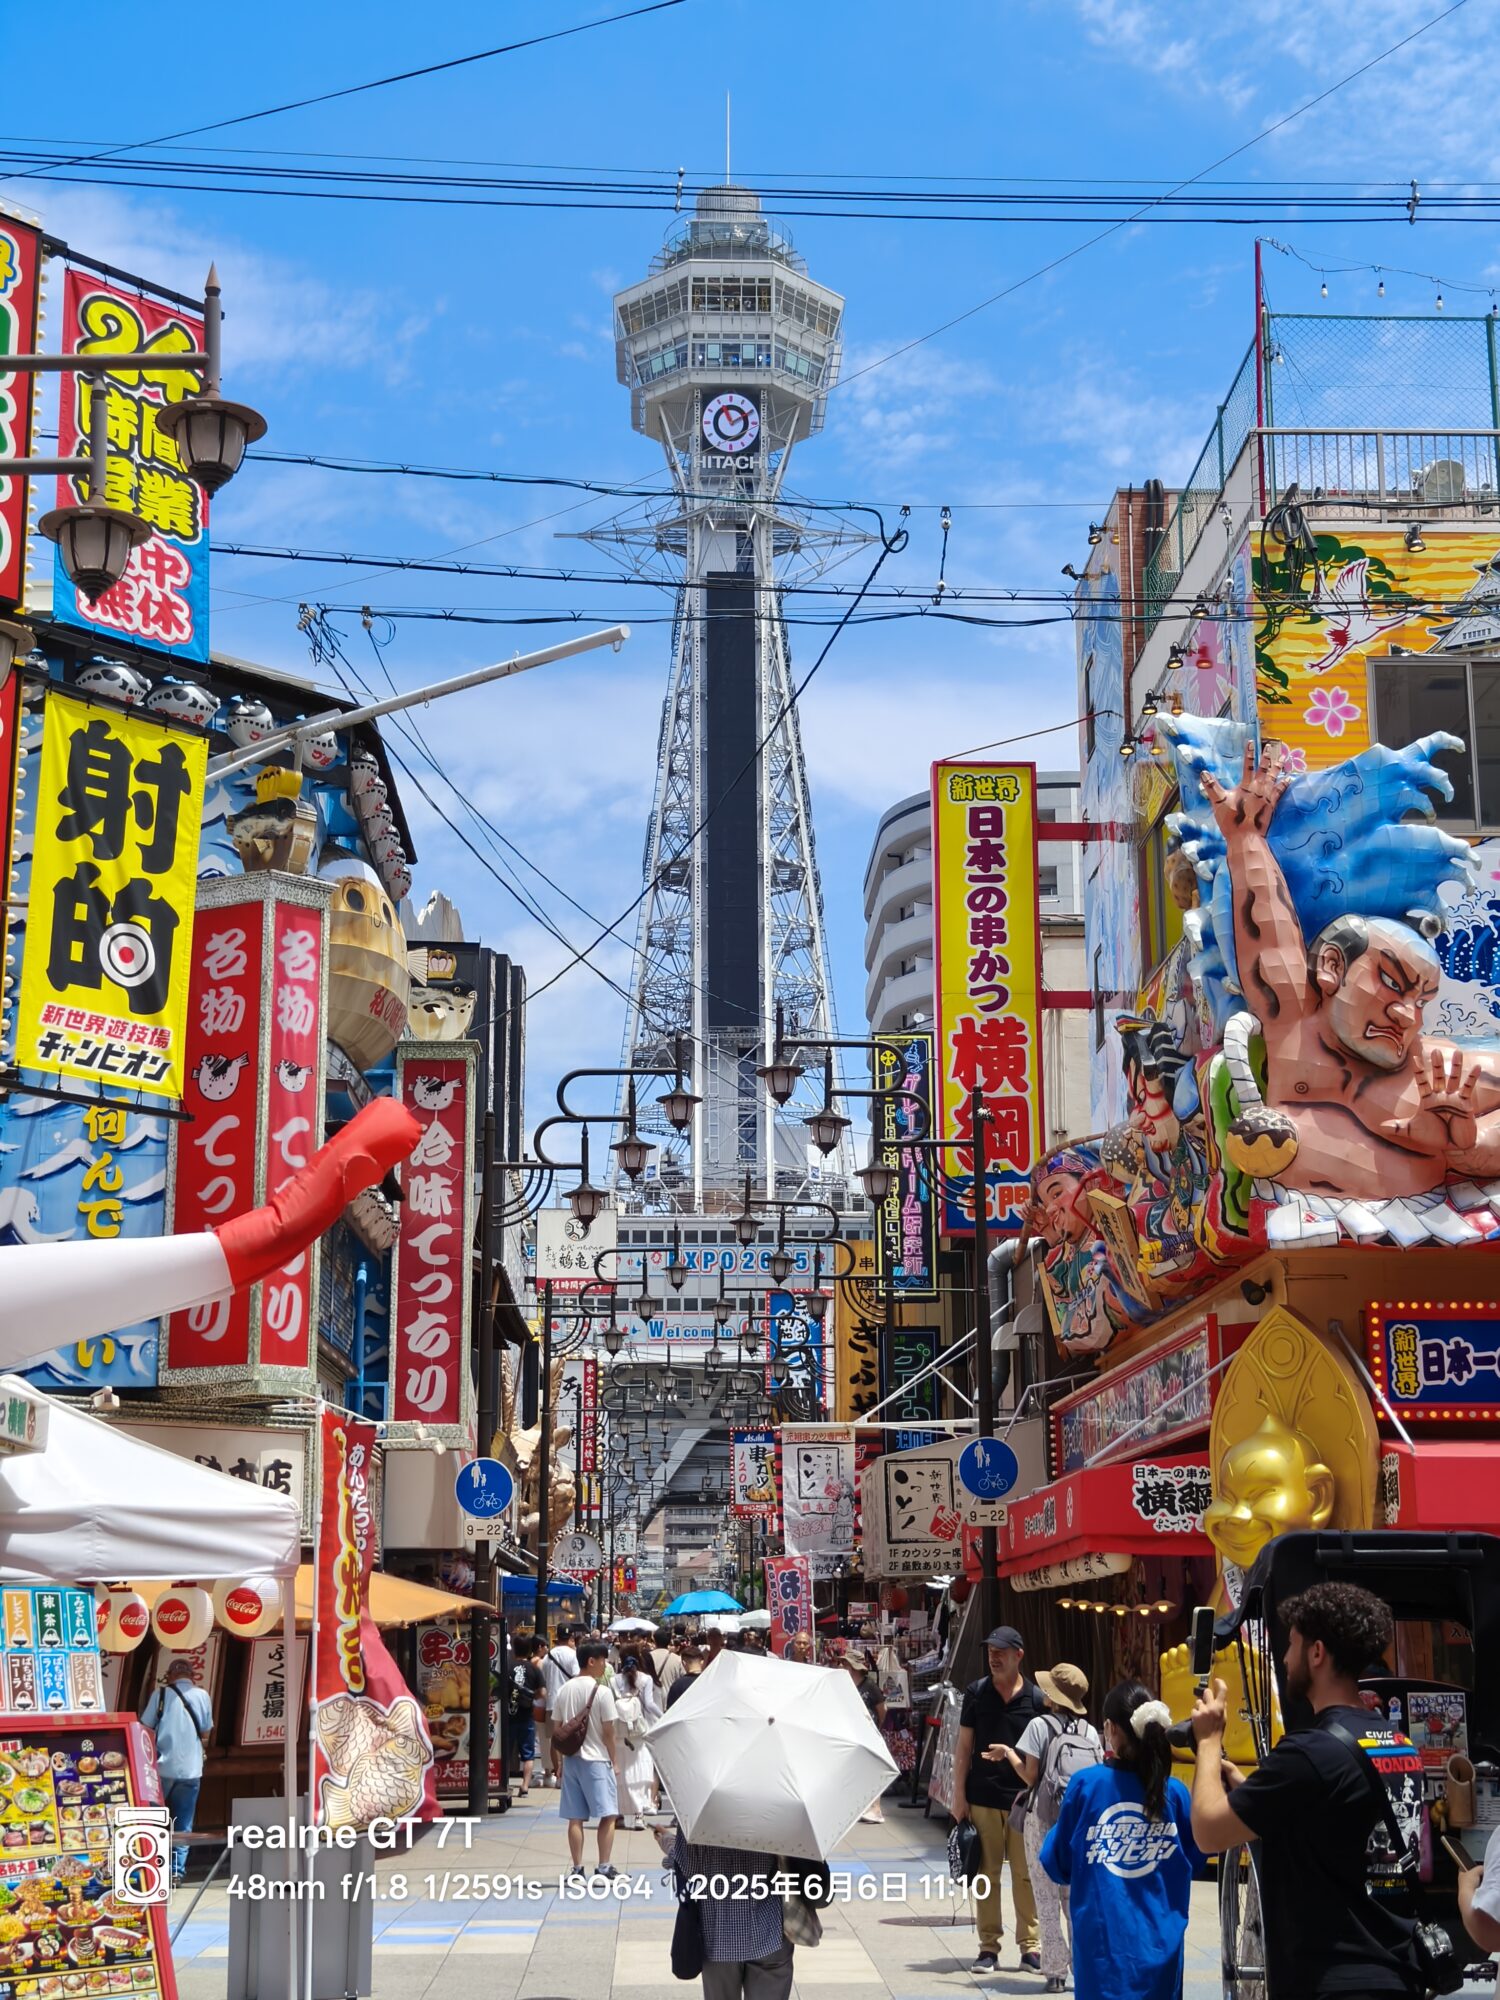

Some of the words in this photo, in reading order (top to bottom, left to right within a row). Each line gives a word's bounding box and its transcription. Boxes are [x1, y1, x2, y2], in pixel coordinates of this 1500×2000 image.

[78, 296, 202, 403] 24
[950, 775, 1021, 801] 新世界
[46, 719, 192, 1015] 射的
[965, 805, 1011, 1013] 日本一の串かつ
[202, 927, 248, 1037] 名物
[276, 927, 317, 1037] 名物
[41, 1005, 171, 1049] 新世界遊技場
[38, 1031, 172, 1082] チャンピオン
[952, 1016, 1031, 1173] 横綱
[188, 1114, 240, 1342] てっり
[404, 1120, 455, 1414] 珍味てっちり
[1392, 1326, 1420, 1396] 新世界
[1421, 1340, 1500, 1383] 日本一
[748, 1444, 769, 1489] 串カツ
[969, 1510, 1006, 1522] 9-22
[1136, 1481, 1213, 1518] 横綱
[466, 1524, 501, 1536] 9-22
[889, 1549, 899, 1558] 1F
[901, 1548, 962, 1558] カウンター席
[889, 1561, 899, 1571] 2F
[901, 1560, 962, 1571] 座敷あります
[12, 1596, 23, 1627] レモン
[41, 1595, 56, 1626] 抹茶
[73, 1596, 86, 1627] みぞれ
[157, 1611, 188, 1622] Coca-Cola
[226, 1599, 259, 1614] Coca-Cola
[11, 1658, 22, 1689] コーラ
[42, 1657, 53, 1688] ラムネ
[1366, 1731, 1394, 1739] CIVIC
[1086, 1837, 1178, 1864] チャンピオン
